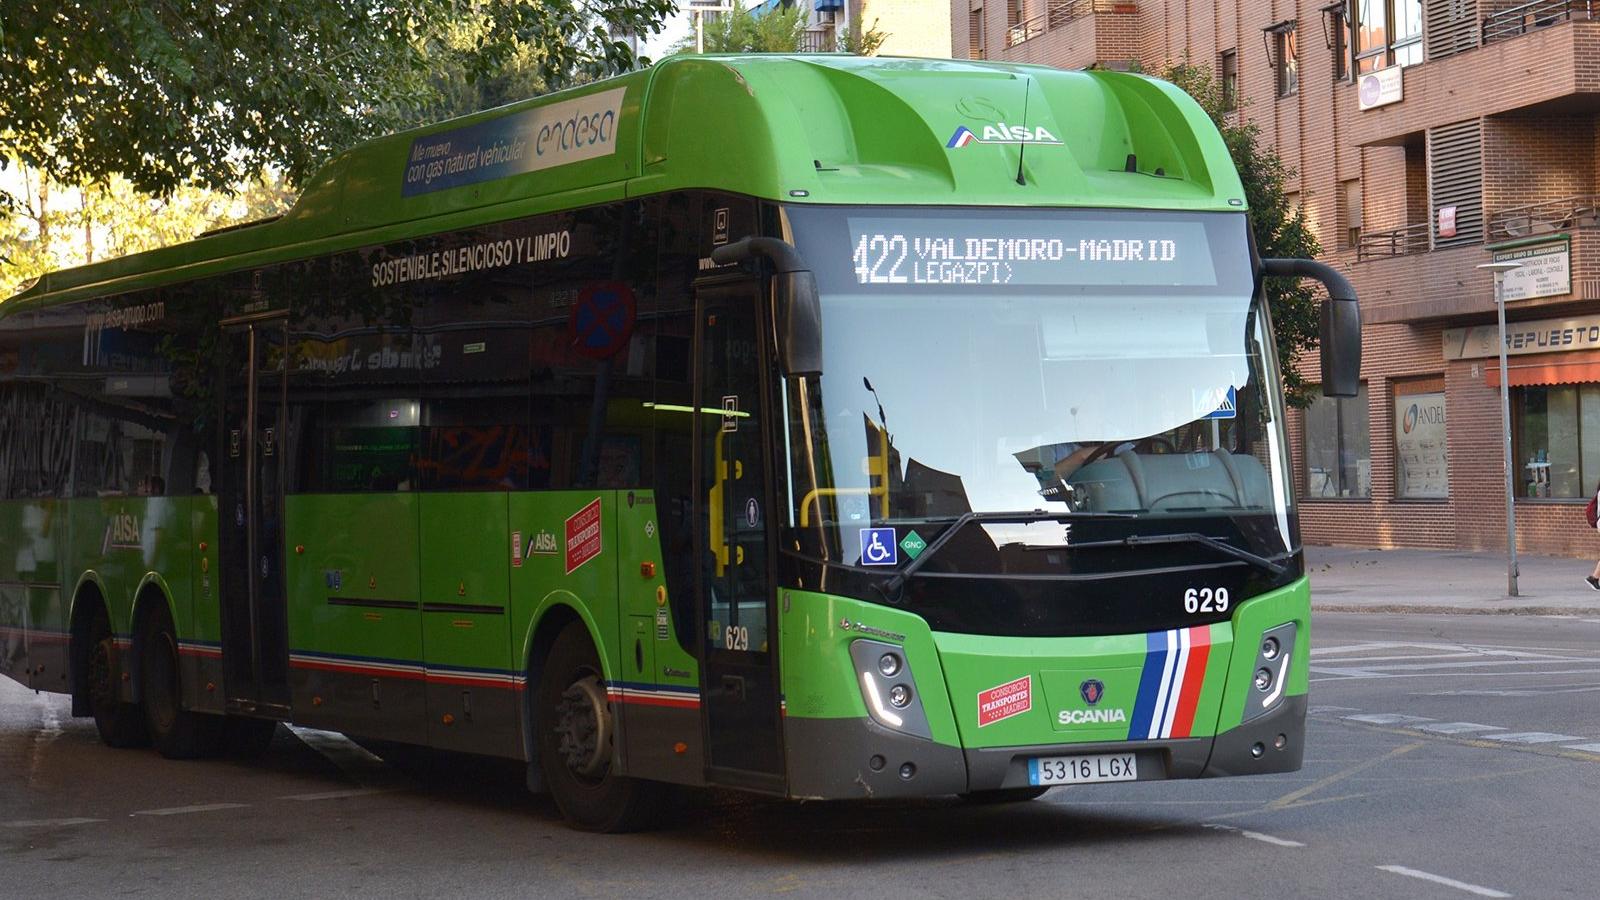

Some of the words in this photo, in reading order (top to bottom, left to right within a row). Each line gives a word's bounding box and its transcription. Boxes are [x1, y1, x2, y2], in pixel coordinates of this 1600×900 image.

[536, 109, 615, 157] endesa
[407, 162, 426, 183] con
[425, 159, 444, 184] gas
[445, 146, 480, 175] natural
[479, 139, 526, 168] vehicular
[411, 144, 427, 163] Me
[425, 141, 451, 159] muevo
[515, 237, 525, 263] Y
[526, 230, 571, 262] LIMPIO
[853, 234, 908, 284] 422
[914, 238, 1176, 261] VALDEMORO-MADRID
[1505, 326, 1600, 349] REPUESTO
[904, 541, 922, 549] GNC
[1184, 587, 1229, 613] 629
[725, 625, 749, 651] 629
[981, 689, 1028, 713] TRANSPORTES
[990, 679, 1028, 700] CONSORCIO
[1003, 700, 1028, 715] MADRID
[1058, 708, 1126, 725] SCANIA
[1043, 759, 1091, 780] 5316
[1098, 756, 1133, 778] LGX
